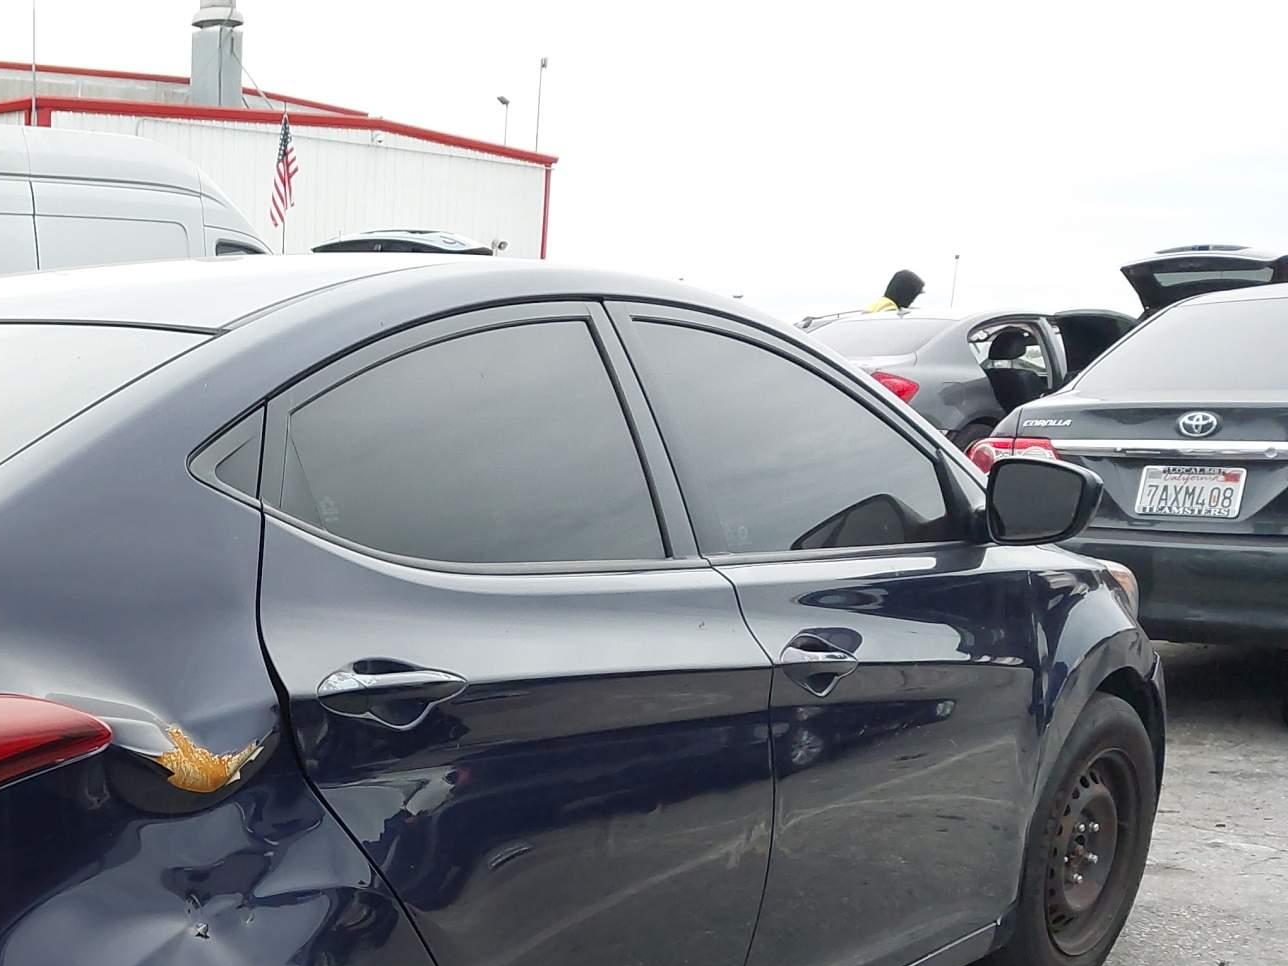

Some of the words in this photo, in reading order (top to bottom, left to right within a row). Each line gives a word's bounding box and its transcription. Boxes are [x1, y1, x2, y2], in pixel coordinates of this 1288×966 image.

[1023, 419, 1072, 427] COROLLA
[1169, 467, 1203, 475] LOCAL
[1147, 485, 1234, 509] 7AXM408
[1143, 505, 1229, 516] TEAMSTERS
